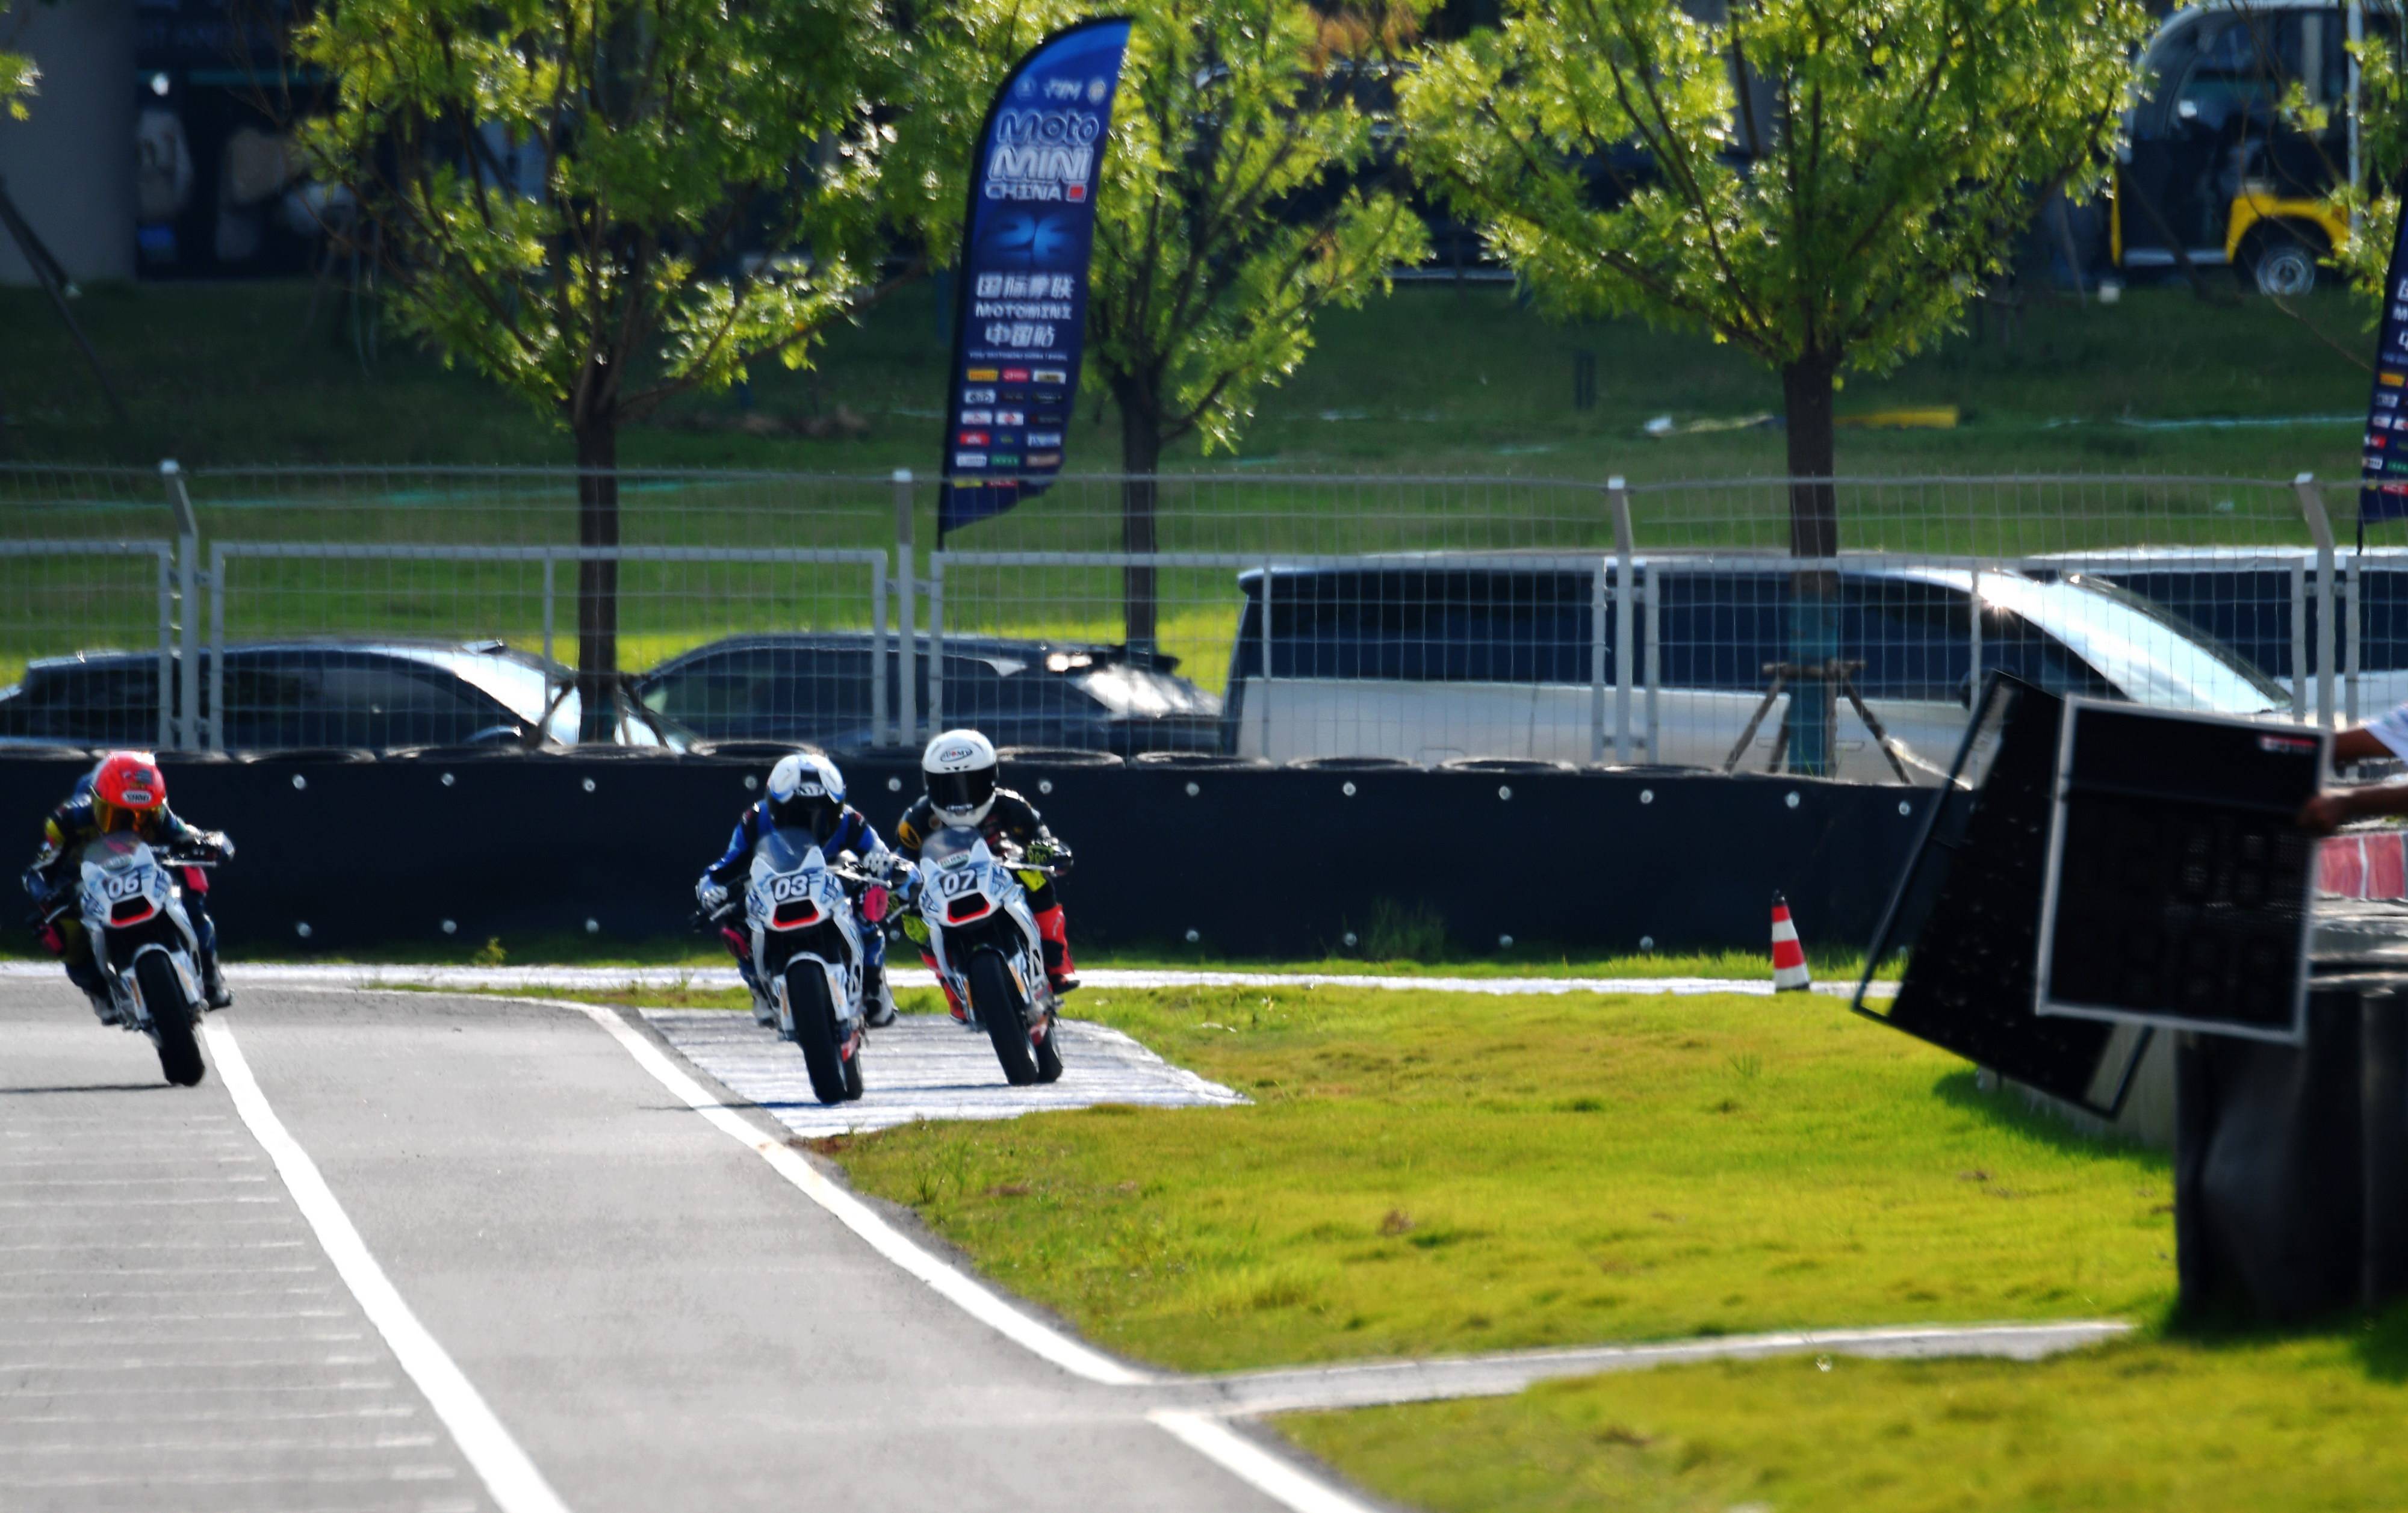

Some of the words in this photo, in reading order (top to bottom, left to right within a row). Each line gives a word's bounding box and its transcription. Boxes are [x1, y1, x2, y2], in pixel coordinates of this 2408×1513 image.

[987, 144, 1094, 183] MINI
[985, 183, 1061, 201] CHINA
[975, 302, 1072, 320] MOTOMINI
[985, 322, 1055, 348] 中国站
[108, 870, 140, 899] 06
[774, 875, 808, 902] 03
[943, 869, 976, 897] 07
